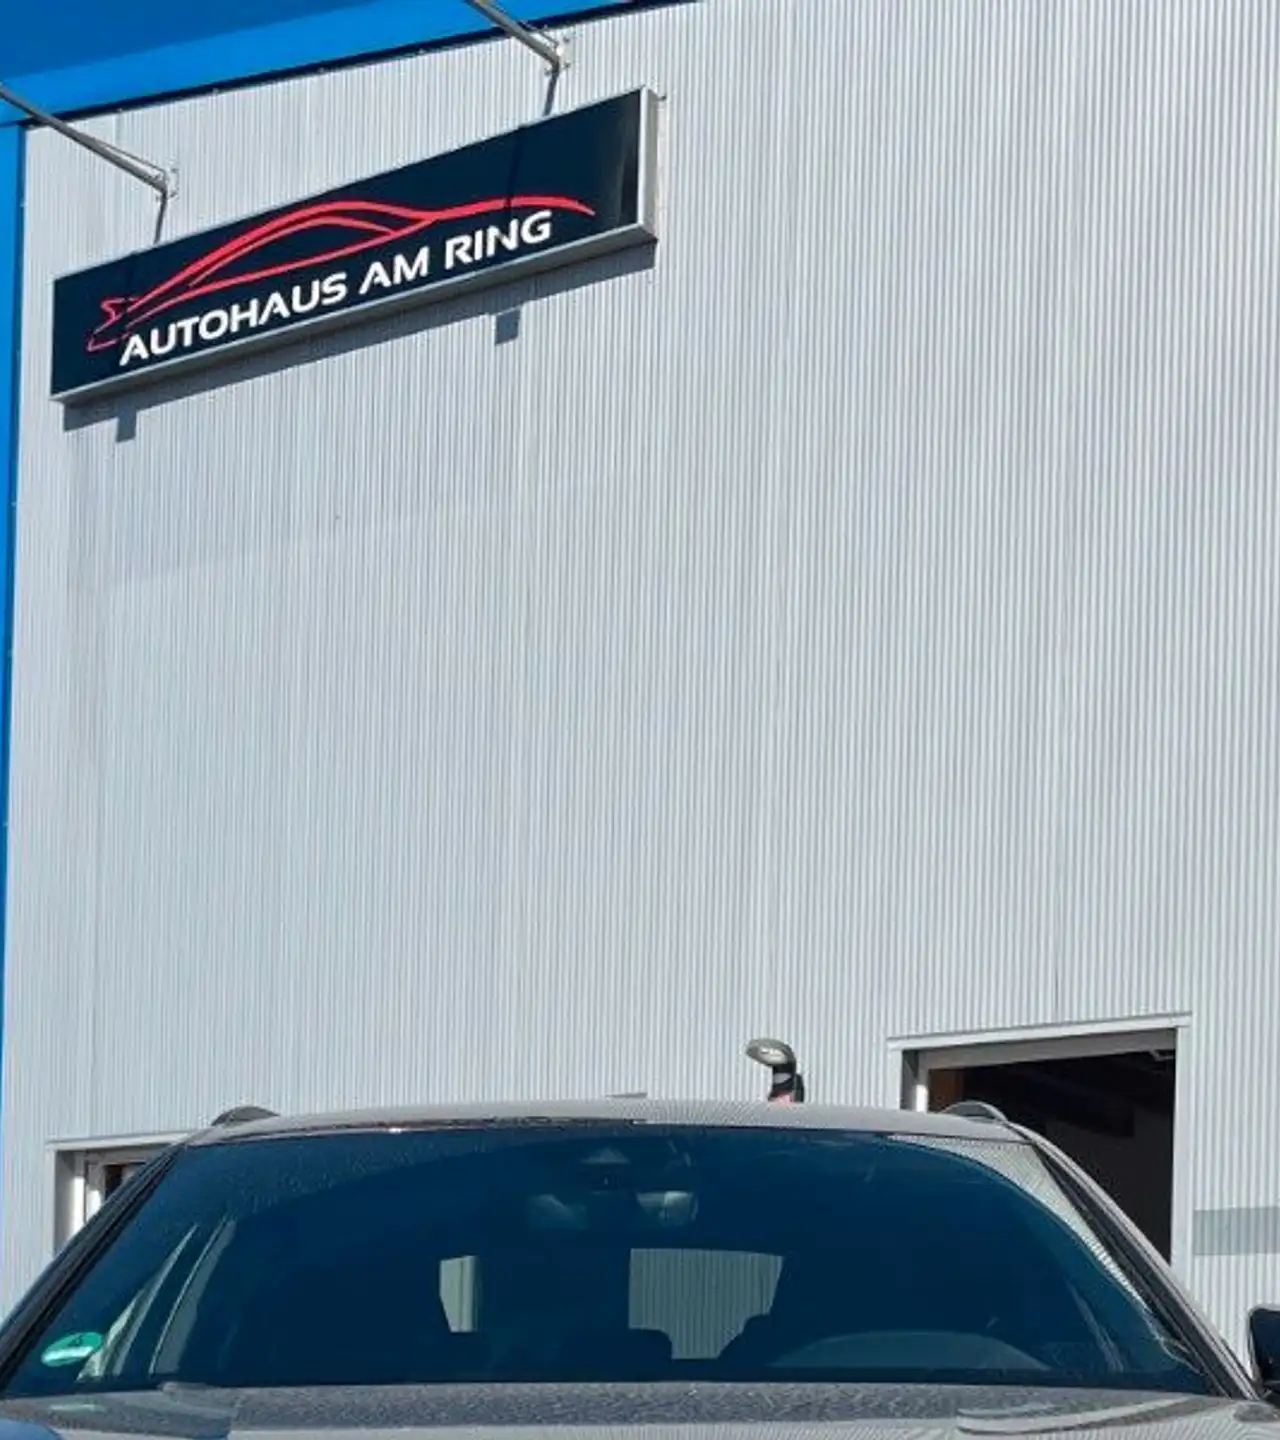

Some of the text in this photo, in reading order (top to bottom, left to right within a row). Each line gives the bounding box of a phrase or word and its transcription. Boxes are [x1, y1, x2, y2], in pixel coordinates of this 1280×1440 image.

[118, 209, 553, 366] AUTOHAUS AM RING
